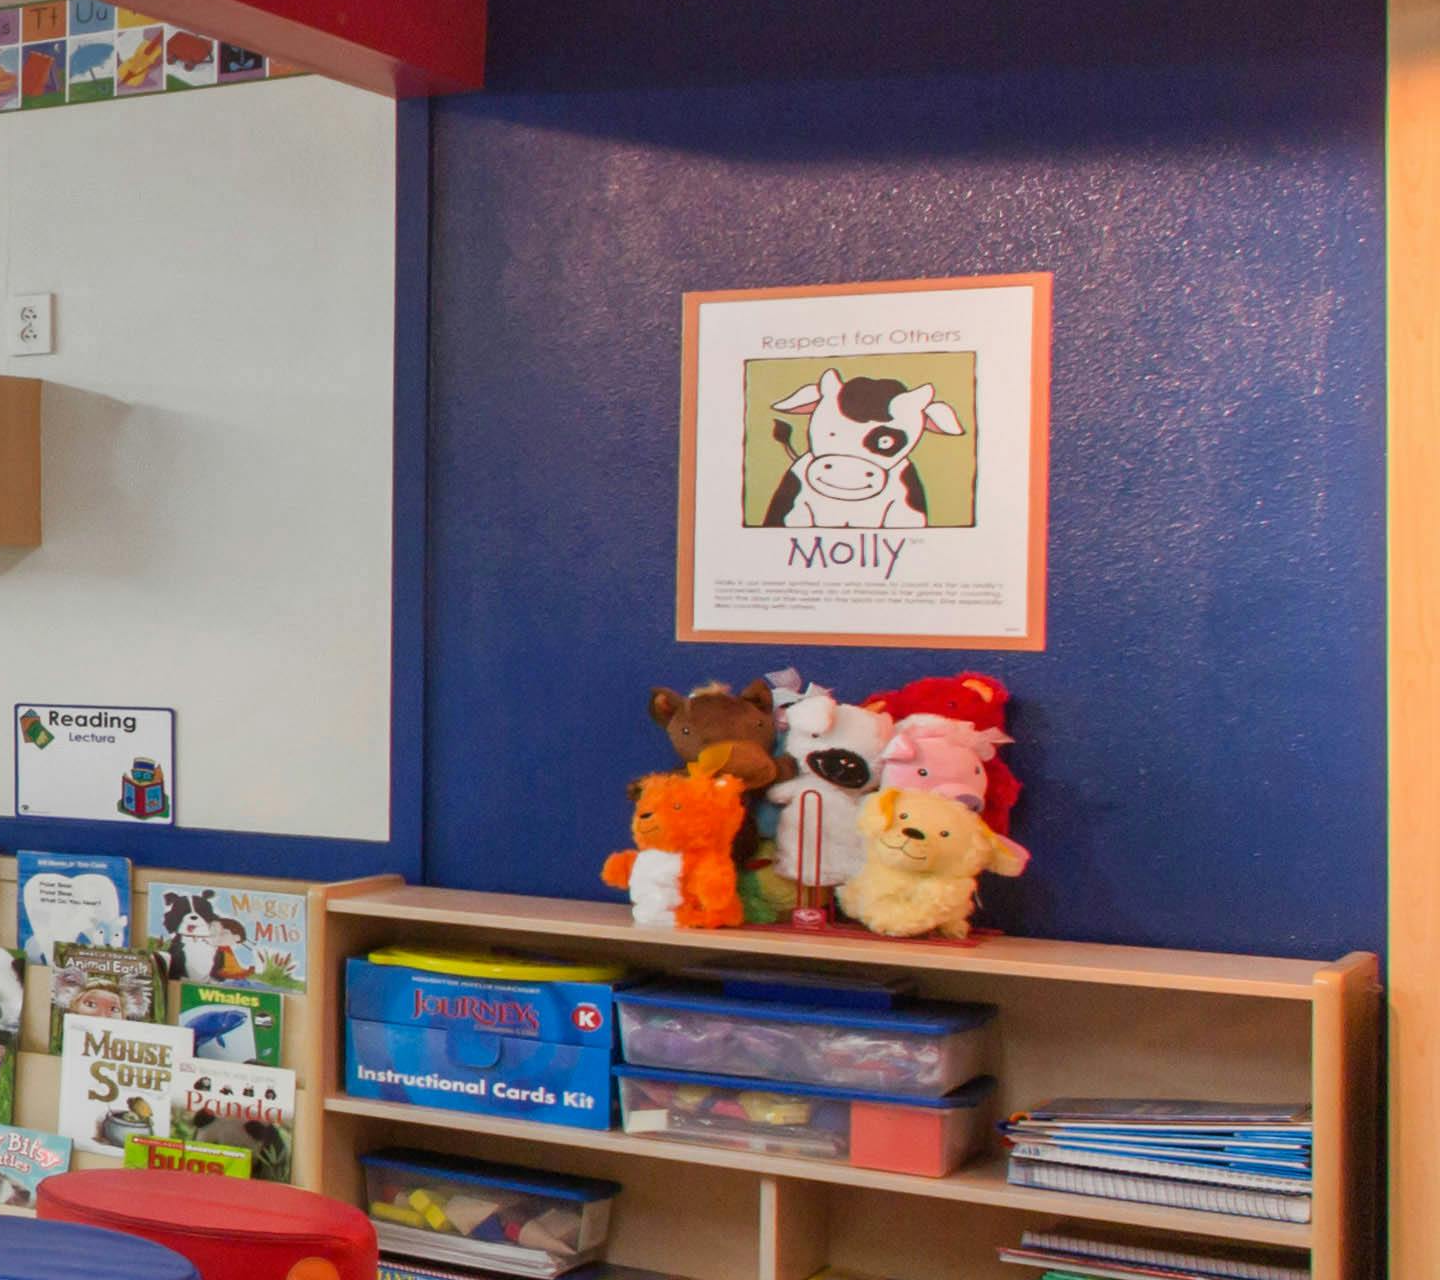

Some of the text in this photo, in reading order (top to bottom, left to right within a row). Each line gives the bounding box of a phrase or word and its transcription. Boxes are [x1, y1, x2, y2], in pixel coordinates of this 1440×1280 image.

[29, 6, 59, 30] Tt
[76, 0, 109, 24] Uu
[761, 327, 962, 352] Respect for Others
[787, 532, 907, 580] Molly
[48, 710, 137, 733] Reading
[68, 731, 116, 744] Lectura
[255, 920, 301, 943] Milo
[65, 957, 110, 972] Animal
[198, 987, 260, 1008] Whales
[578, 1010, 596, 1027] K
[357, 1064, 595, 1110] Instructional Cards Kit
[185, 1089, 284, 1125] Panda
[7, 1132, 63, 1170] Bitsy
